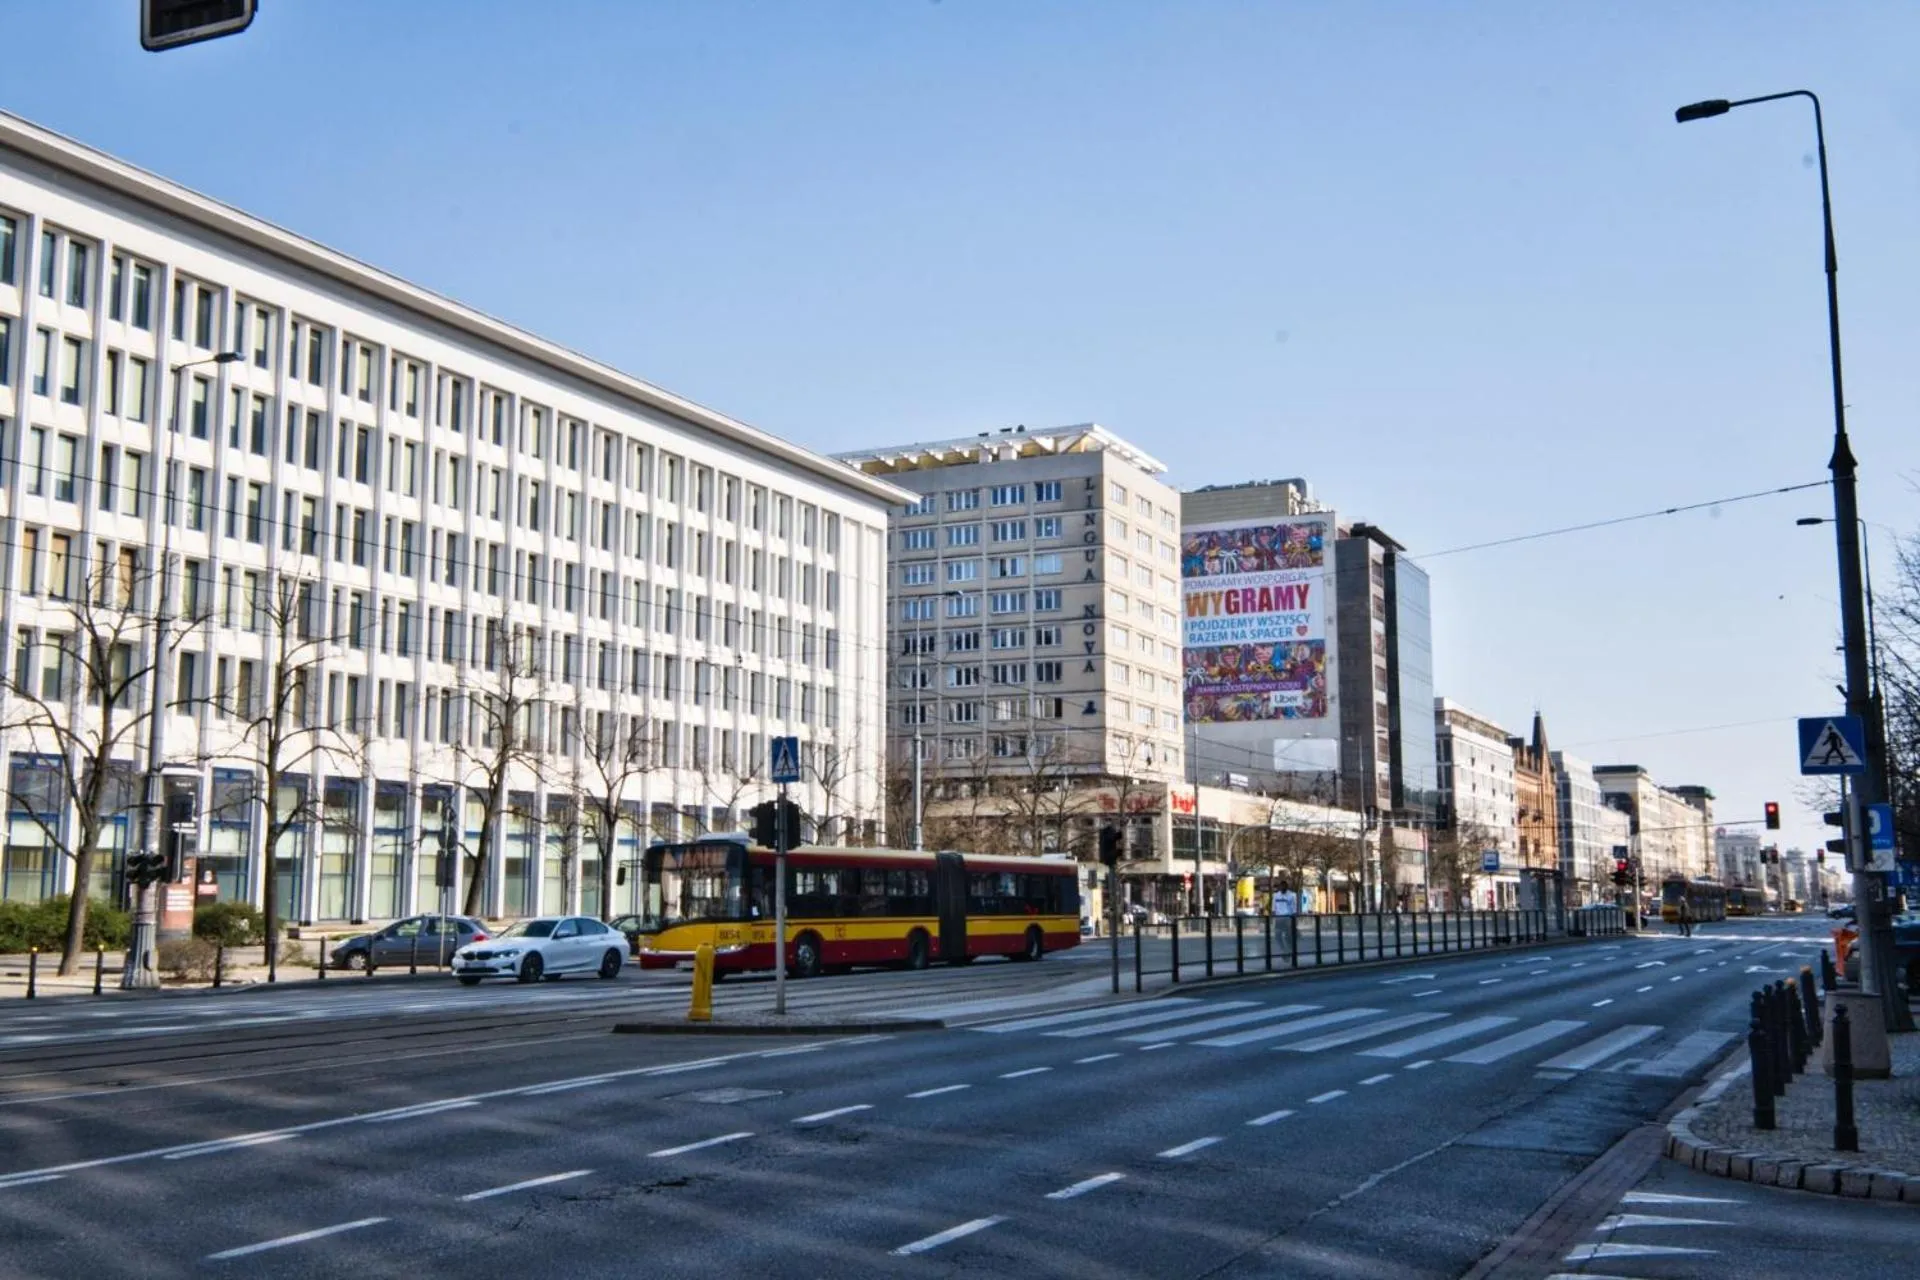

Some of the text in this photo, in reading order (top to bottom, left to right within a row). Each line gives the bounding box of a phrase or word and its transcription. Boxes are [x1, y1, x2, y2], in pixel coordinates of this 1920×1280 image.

[1083, 477, 1097, 673] LINGUA NOVA
[1185, 584, 1310, 617] WYGRAMY
[1256, 613, 1311, 627] WSZYSCY
[1189, 626, 1293, 643] RAZEM NA SPACER
[1274, 694, 1298, 703] Uber
